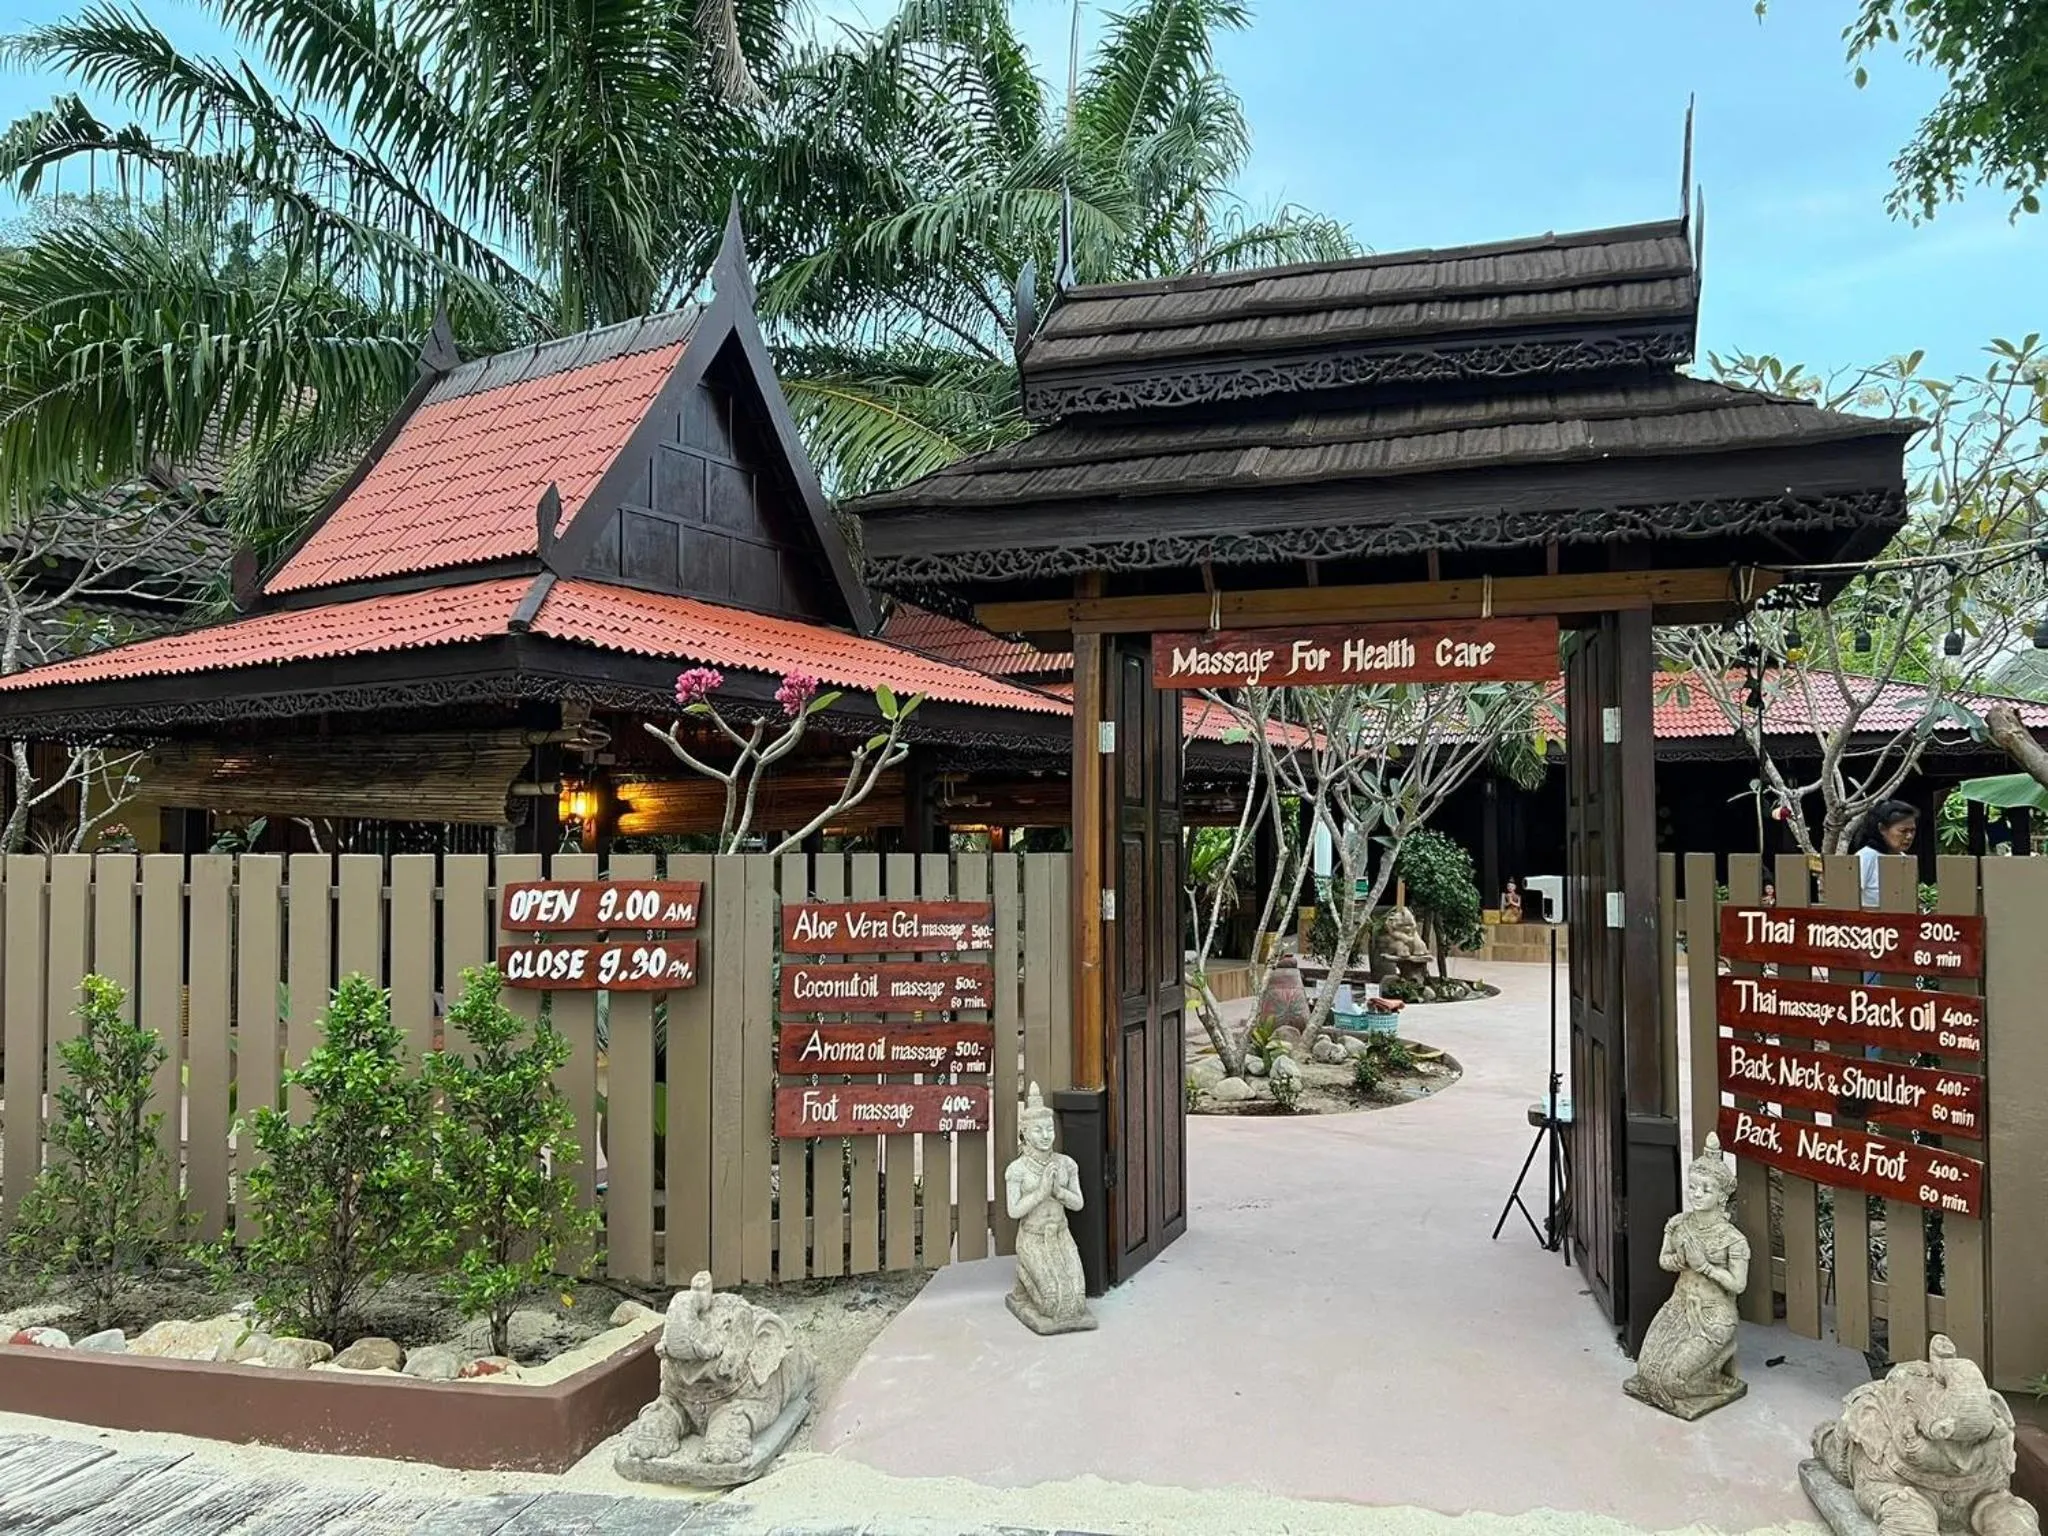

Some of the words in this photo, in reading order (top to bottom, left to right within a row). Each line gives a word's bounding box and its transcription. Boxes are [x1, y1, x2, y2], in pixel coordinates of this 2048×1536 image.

[1169, 646, 1274, 685] Massage
[1286, 639, 1330, 675] For
[1342, 638, 1416, 673] Health
[1435, 638, 1496, 669] Care
[509, 888, 581, 923] OPEN
[597, 888, 660, 922] 9.00
[662, 903, 696, 922] AM.
[792, 909, 837, 942] Aloe
[845, 911, 888, 939] Vera
[893, 911, 919, 938] Gel
[922, 923, 966, 940] massage
[1738, 911, 1795, 944] Thai
[1807, 922, 1899, 958] massage
[956, 940, 968, 950] 60
[1914, 951, 1931, 965] 60
[1936, 951, 1961, 968] min
[508, 949, 589, 980] CLOSE
[597, 947, 667, 985] 9.30
[891, 980, 946, 1001] massage
[951, 996, 962, 1009] 60
[1732, 979, 1777, 1014] Thai
[1779, 999, 1836, 1026] massage
[1837, 1006, 1848, 1022] &
[1850, 989, 1904, 1028] Back
[799, 1029, 864, 1062] Aroma
[868, 1037, 886, 1061] oil
[891, 1045, 947, 1067] massage
[1939, 1031, 1956, 1047] 60
[1957, 1034, 1980, 1051] min
[950, 1061, 963, 1072] 60
[966, 1060, 986, 1072] min
[1729, 1044, 1777, 1086] Back,
[1778, 1056, 1829, 1092] Neck
[1827, 1074, 1840, 1095] &
[1841, 1067, 1927, 1107] Shoulder
[801, 1090, 840, 1125] Foot
[853, 1102, 914, 1128] massage
[939, 1118, 953, 1132] 60
[1931, 1103, 1948, 1121] 60
[1950, 1108, 1975, 1127] min
[1734, 1112, 1783, 1153] Back,
[1797, 1129, 1846, 1171] Neck
[1848, 1152, 1861, 1172] &
[1861, 1141, 1909, 1182] Foot
[1919, 1185, 1938, 1203] 60
